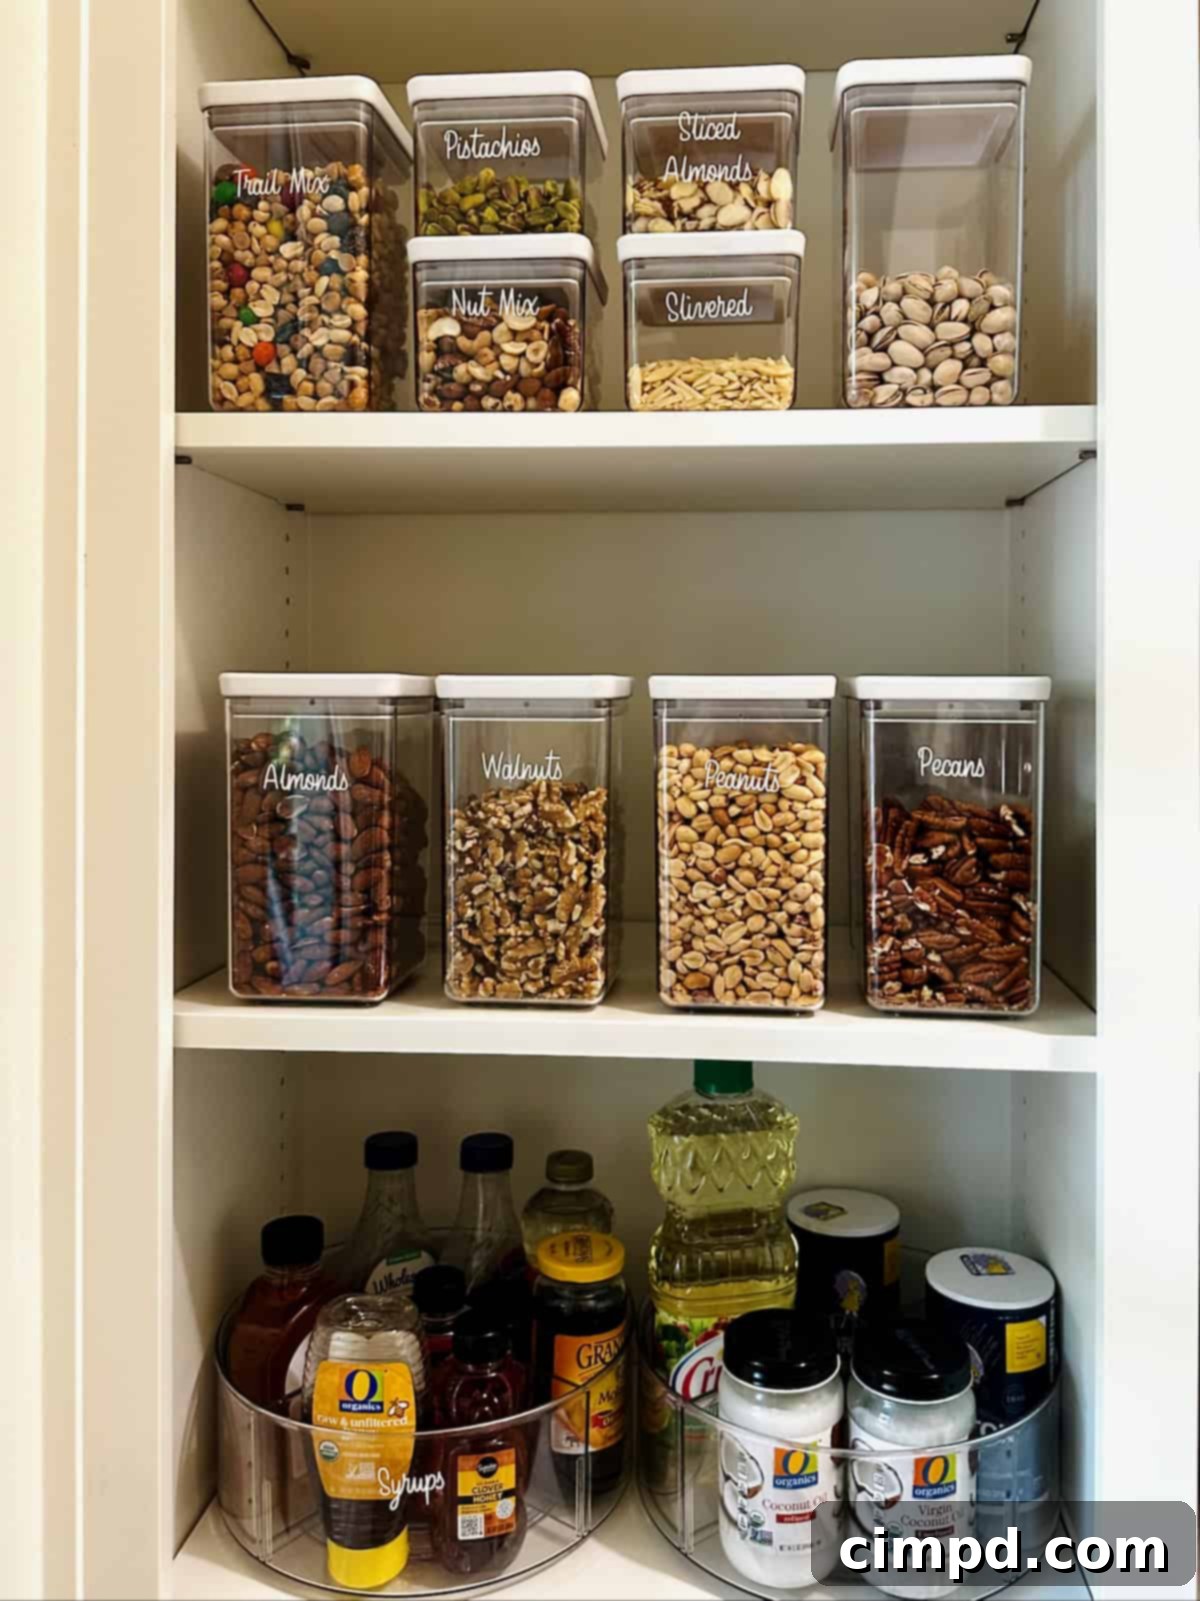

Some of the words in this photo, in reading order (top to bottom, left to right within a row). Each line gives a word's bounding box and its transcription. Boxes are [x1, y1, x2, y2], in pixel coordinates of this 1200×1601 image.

[677, 111, 741, 143] Sliced
[443, 126, 541, 161] Pistachios
[233, 167, 282, 198] Trail
[288, 165, 331, 196] Mix
[662, 153, 754, 184] Almonds
[451, 284, 493, 318] Nut
[499, 287, 540, 317] Mix
[664, 287, 753, 323] Slivered
[262, 763, 349, 793] Almonds
[481, 749, 564, 782] Walnuts
[703, 758, 781, 794] Peanuts
[917, 746, 986, 779] Pecans
[681, 1355, 722, 1402] Cri
[341, 1401, 382, 1412] organics
[350, 1415, 409, 1429] unfiltered
[376, 1466, 446, 1511] Syrups
[774, 1474, 817, 1488] organics
[914, 1483, 956, 1497] organics
[761, 1497, 811, 1512] Coconut
[900, 1513, 951, 1527] Coconut
[918, 1502, 953, 1517] Virgin
